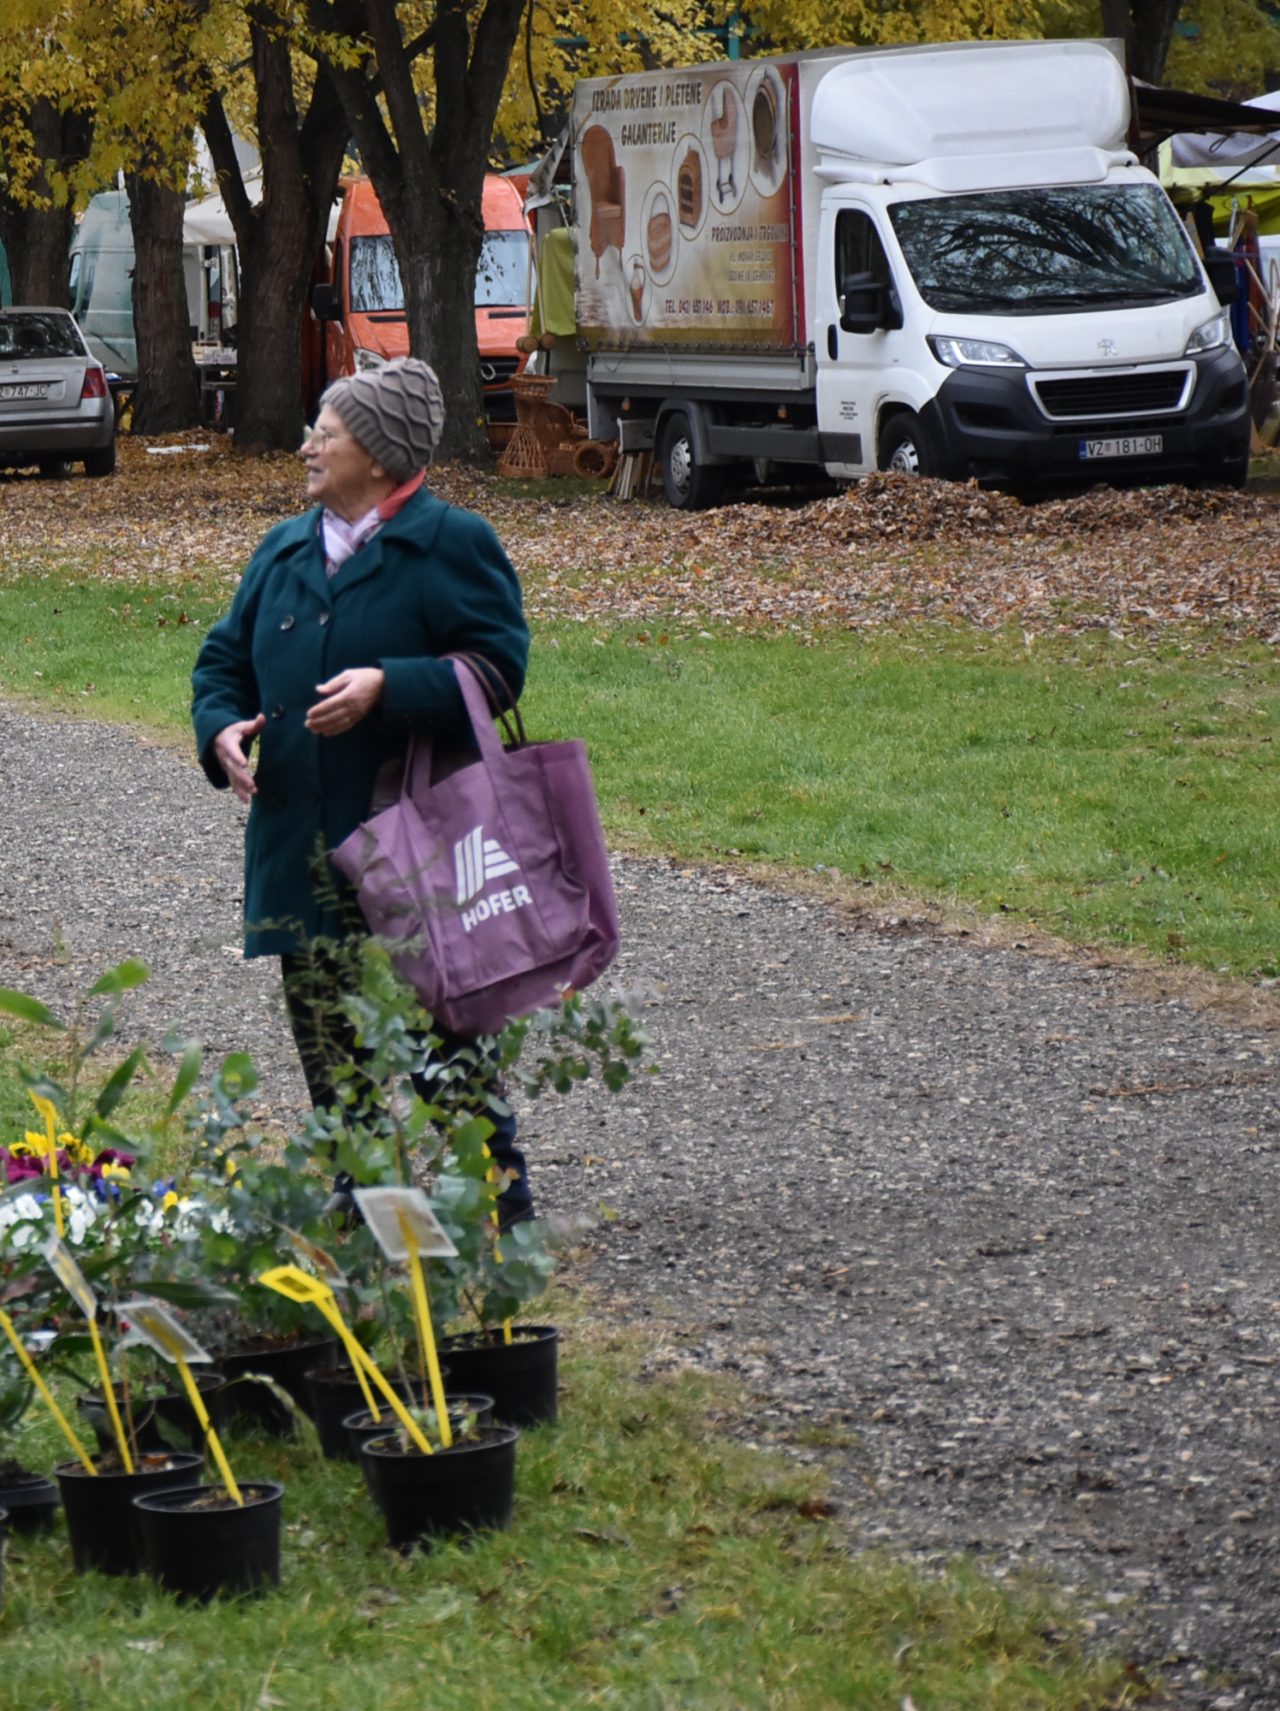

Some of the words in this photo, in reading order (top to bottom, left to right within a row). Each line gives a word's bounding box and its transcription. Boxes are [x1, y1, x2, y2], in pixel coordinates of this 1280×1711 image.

[592, 89, 621, 113] IZRADA
[623, 86, 657, 110] DRVENE
[665, 82, 702, 107] PLETENE
[621, 121, 676, 146] GALANTERIJE
[1088, 441, 1103, 456] VZ
[1116, 437, 1162, 454] 181-OH
[461, 885, 534, 933] HOFER
